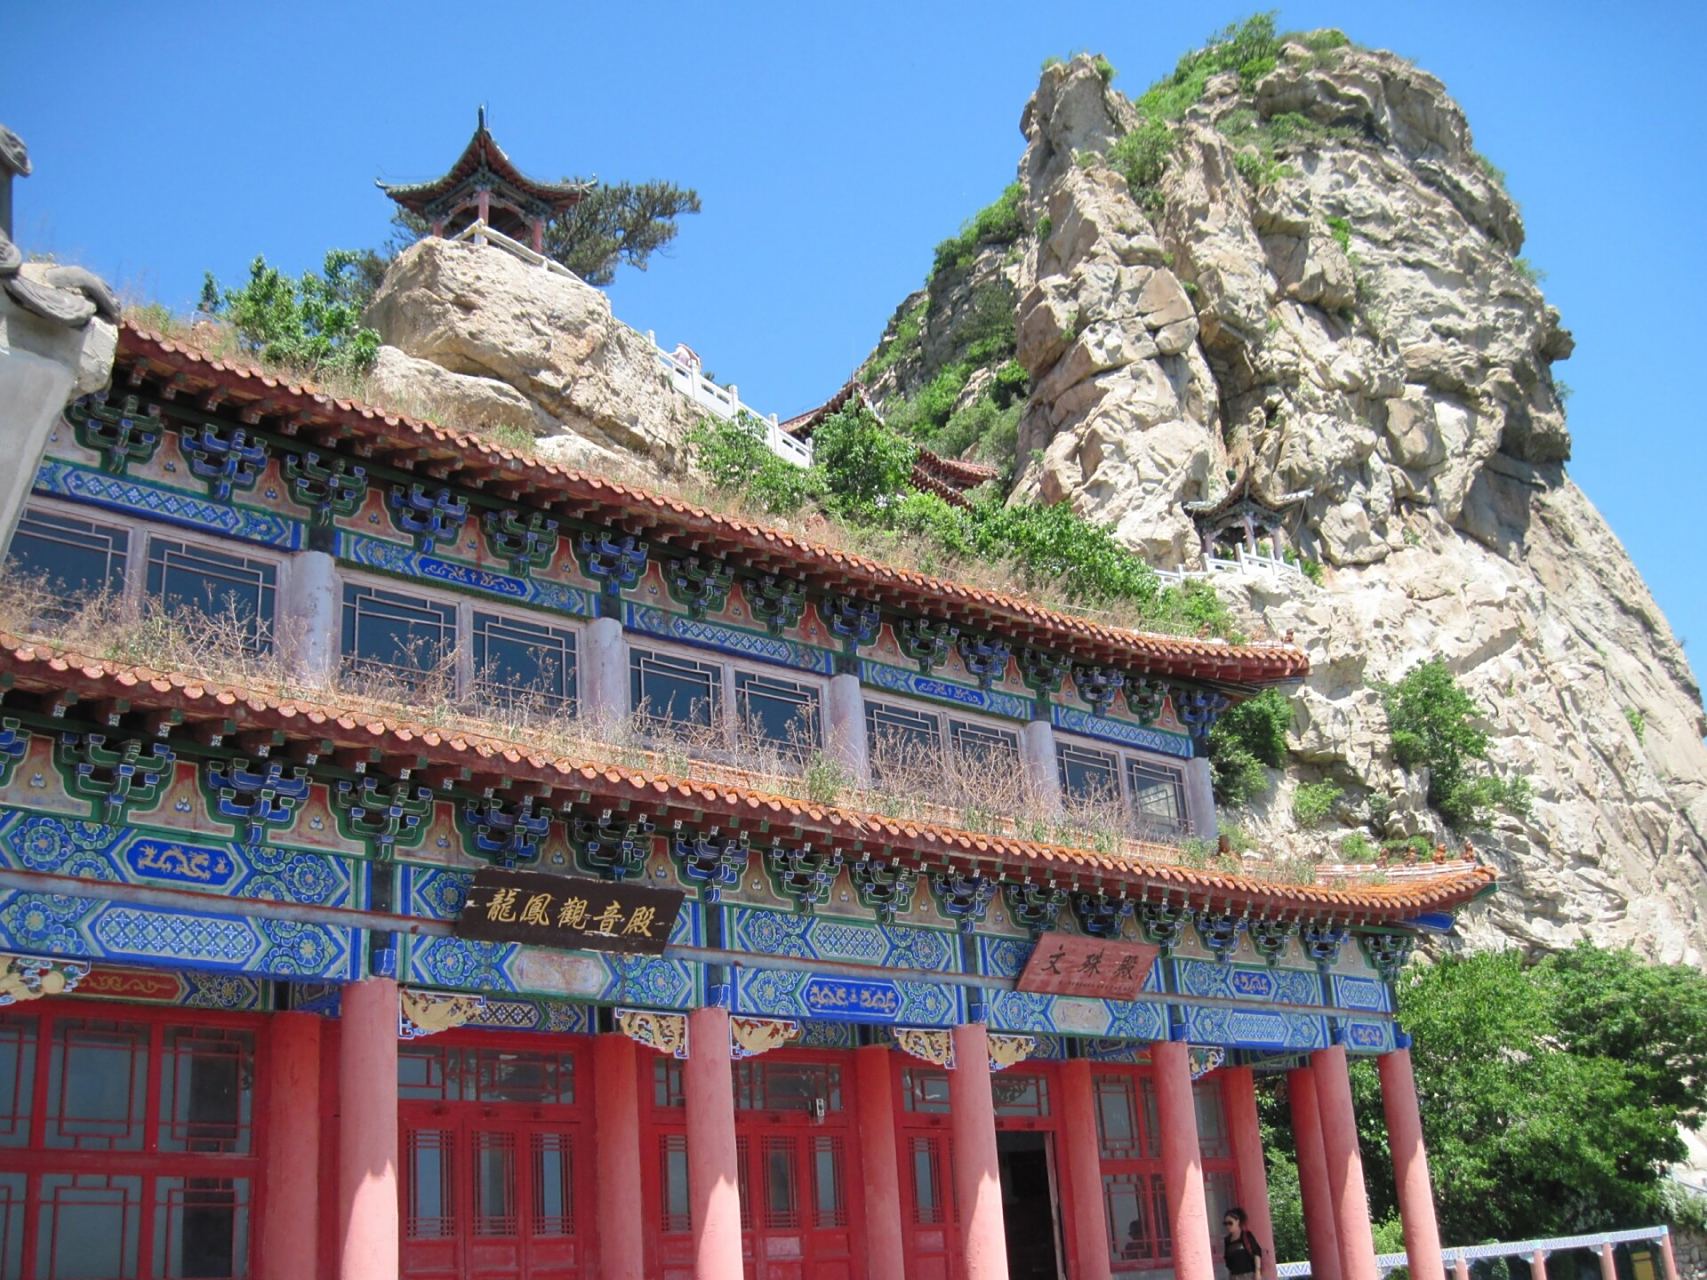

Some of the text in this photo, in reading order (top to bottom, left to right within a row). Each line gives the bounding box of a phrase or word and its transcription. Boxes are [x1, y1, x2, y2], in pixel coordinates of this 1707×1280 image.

[486, 888, 656, 937] 龍鳳觀音殿
